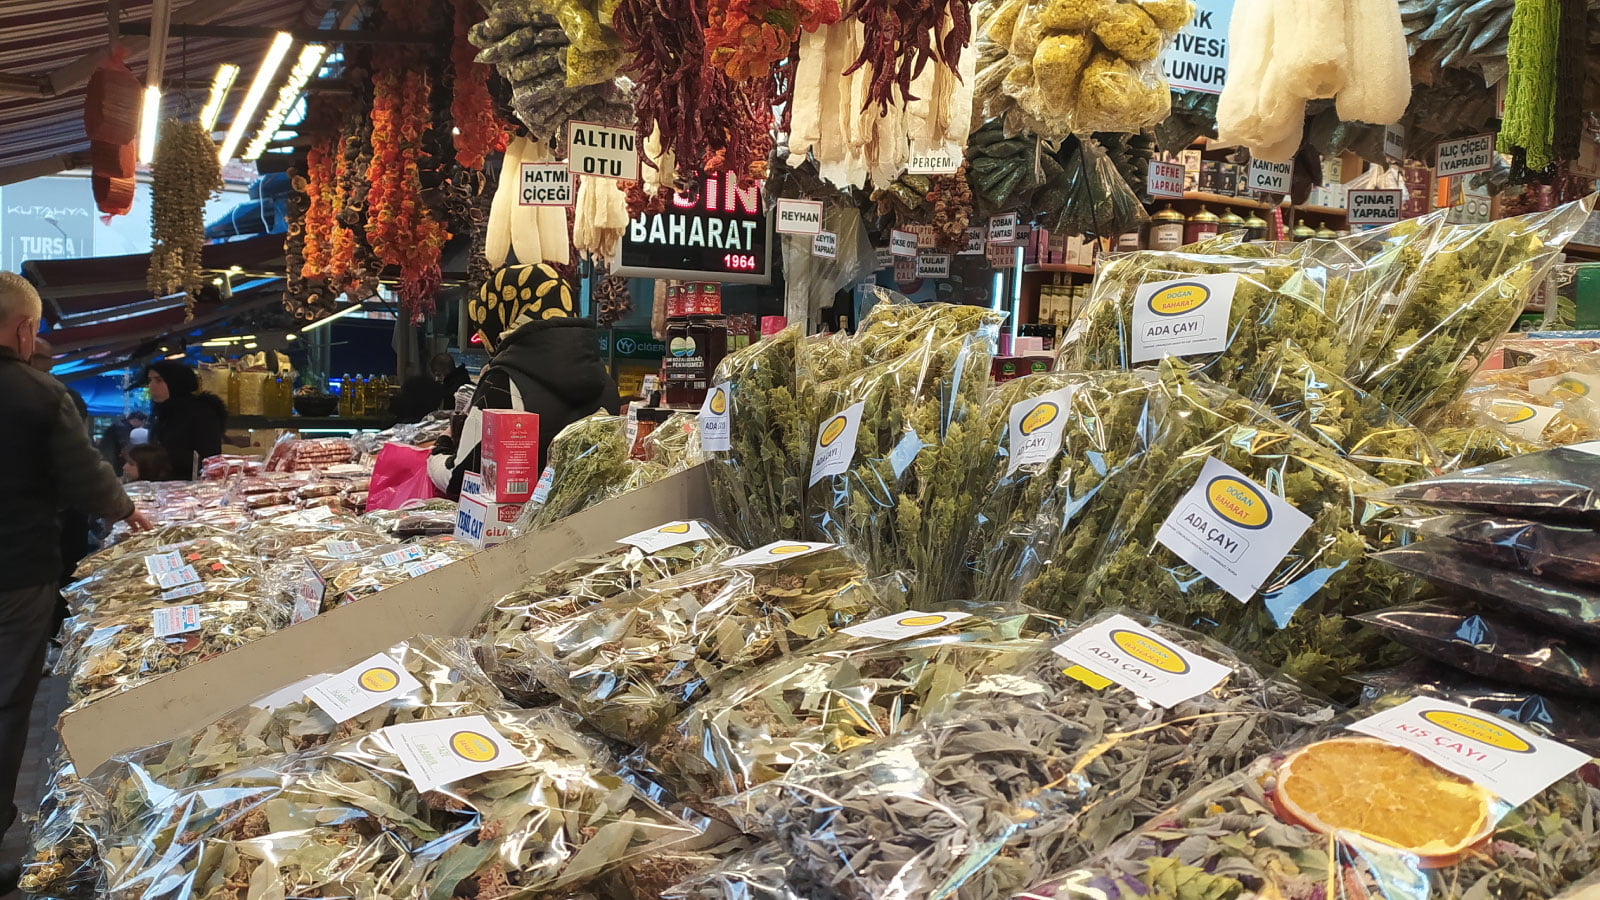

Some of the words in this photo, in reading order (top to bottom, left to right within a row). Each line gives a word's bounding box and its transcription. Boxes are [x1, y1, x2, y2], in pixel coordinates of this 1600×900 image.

[573, 128, 634, 151] ALTIN
[1439, 145, 1458, 158] ALIÇ
[1460, 139, 1489, 154] ÇİÇEĞİ
[583, 156, 622, 177] OTU
[1440, 155, 1488, 171] (YAPRAĞI)
[525, 167, 569, 182] HATMİ
[1155, 165, 1180, 179] DEFNE
[1256, 174, 1282, 187] ÇAYI
[523, 185, 570, 203] ÇİÇEĞİ
[1354, 194, 1394, 206] ÇINAR
[781, 211, 819, 223] REYHAN
[1352, 207, 1399, 219] YAPRAĞI
[630, 211, 757, 251] BAHARAT
[724, 253, 756, 269] 1964
[921, 257, 945, 265] YULAF
[919, 266, 946, 274] SAMANI
[1166, 290, 1192, 299] DOĞAN
[1162, 299, 1194, 310] BAHARAT
[1146, 325, 1170, 337] ADA
[1173, 321, 1198, 336] ÇAYI
[705, 422, 718, 430] ADA
[1226, 486, 1254, 507] DOĞAN
[1216, 494, 1249, 519] BAHARAT
[1184, 512, 1208, 533] ADA
[1207, 528, 1238, 554] ÇAYI
[1087, 646, 1119, 664] ADA
[1121, 662, 1157, 683] ÇAYI
[1396, 723, 1428, 738] KIŞ
[1434, 736, 1488, 762] ÇAYI
